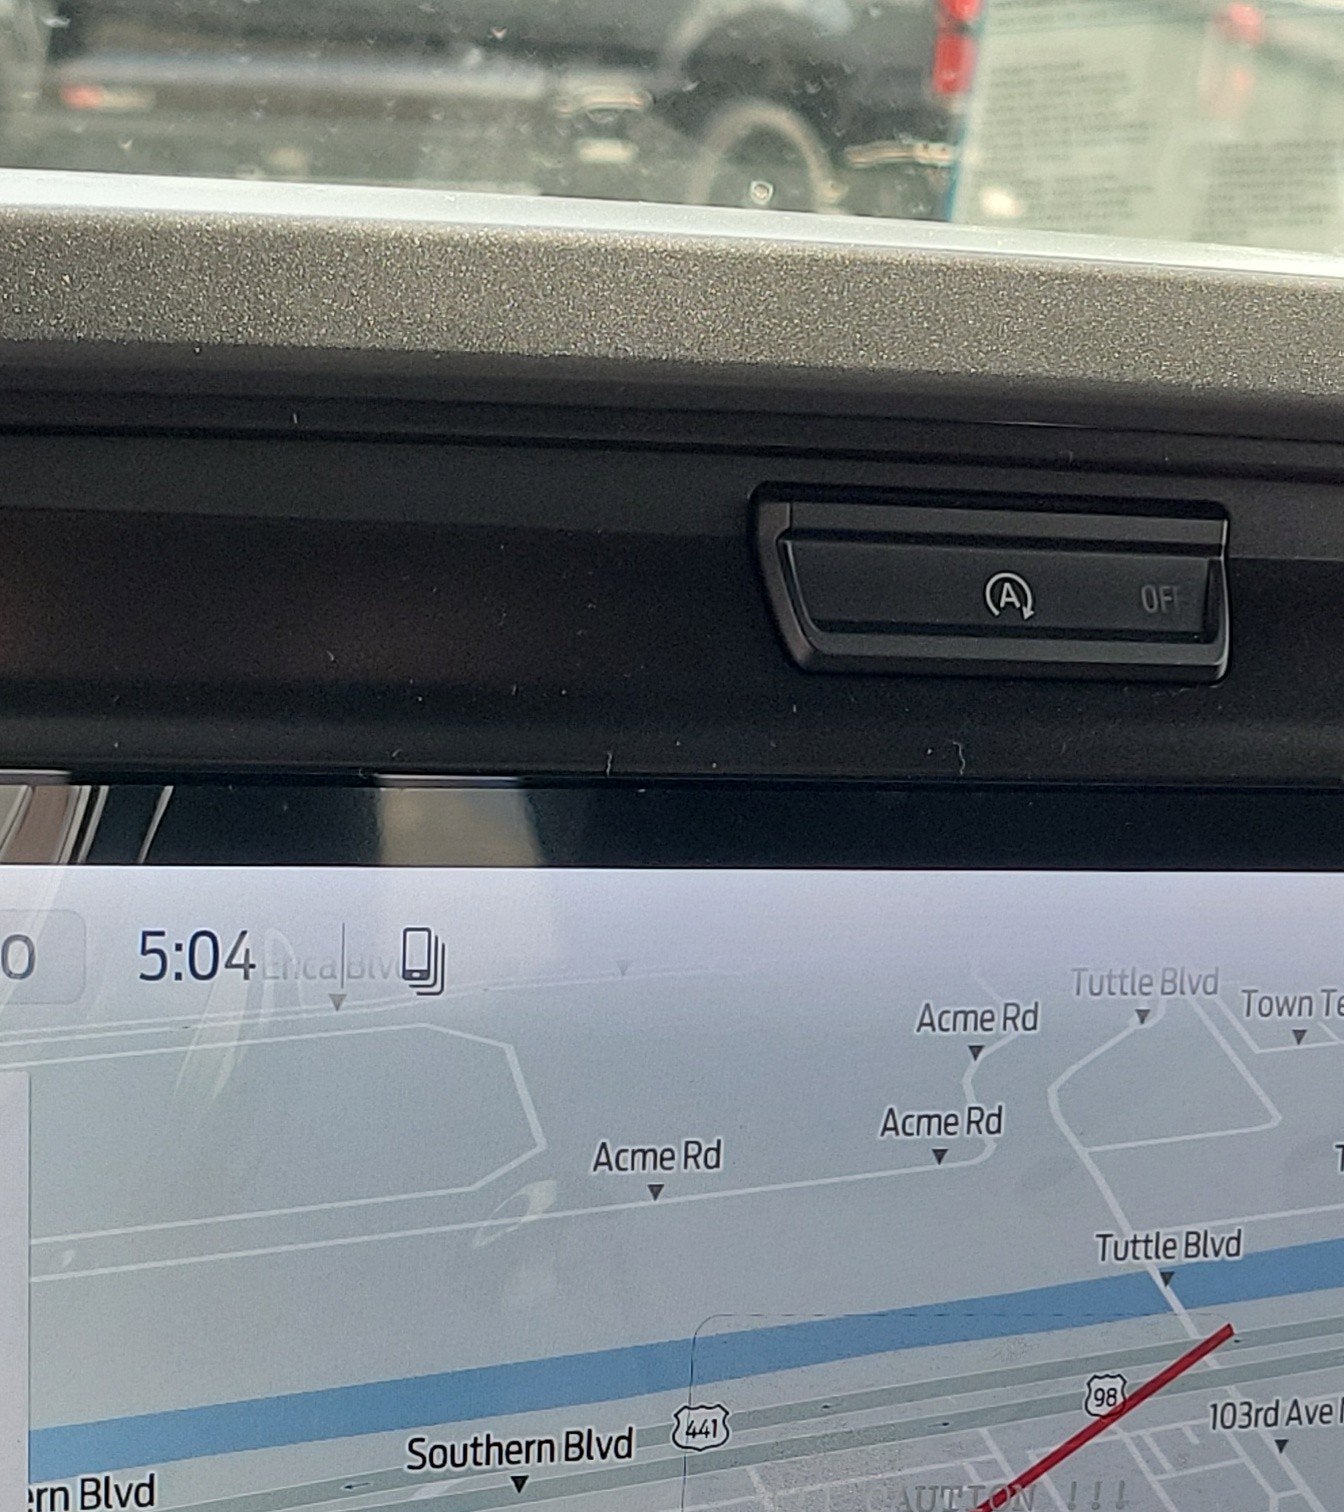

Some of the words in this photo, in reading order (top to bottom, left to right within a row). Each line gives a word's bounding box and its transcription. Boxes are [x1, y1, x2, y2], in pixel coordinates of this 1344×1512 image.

[138, 929, 256, 981] 5:04
[1072, 969, 1152, 997] Tuttle
[1160, 967, 1219, 996] Blvd
[917, 1004, 994, 1032] Acme
[1002, 1003, 1039, 1031] Rd
[1242, 991, 1313, 1019] Town
[880, 1108, 956, 1137] Acme
[966, 1106, 1003, 1136] Rd
[592, 1143, 673, 1172] Acme
[682, 1141, 722, 1170] Rd
[1095, 1233, 1175, 1262] Tuttle
[1182, 1231, 1242, 1261] Blvd
[1093, 1387, 1117, 1408] 98
[685, 1417, 718, 1440] 441
[1209, 1400, 1280, 1431] 103rd
[1285, 1399, 1335, 1427] Ave
[406, 1436, 555, 1472] Southern
[564, 1429, 633, 1463] Blvd
[80, 1474, 155, 1509] Blvd
